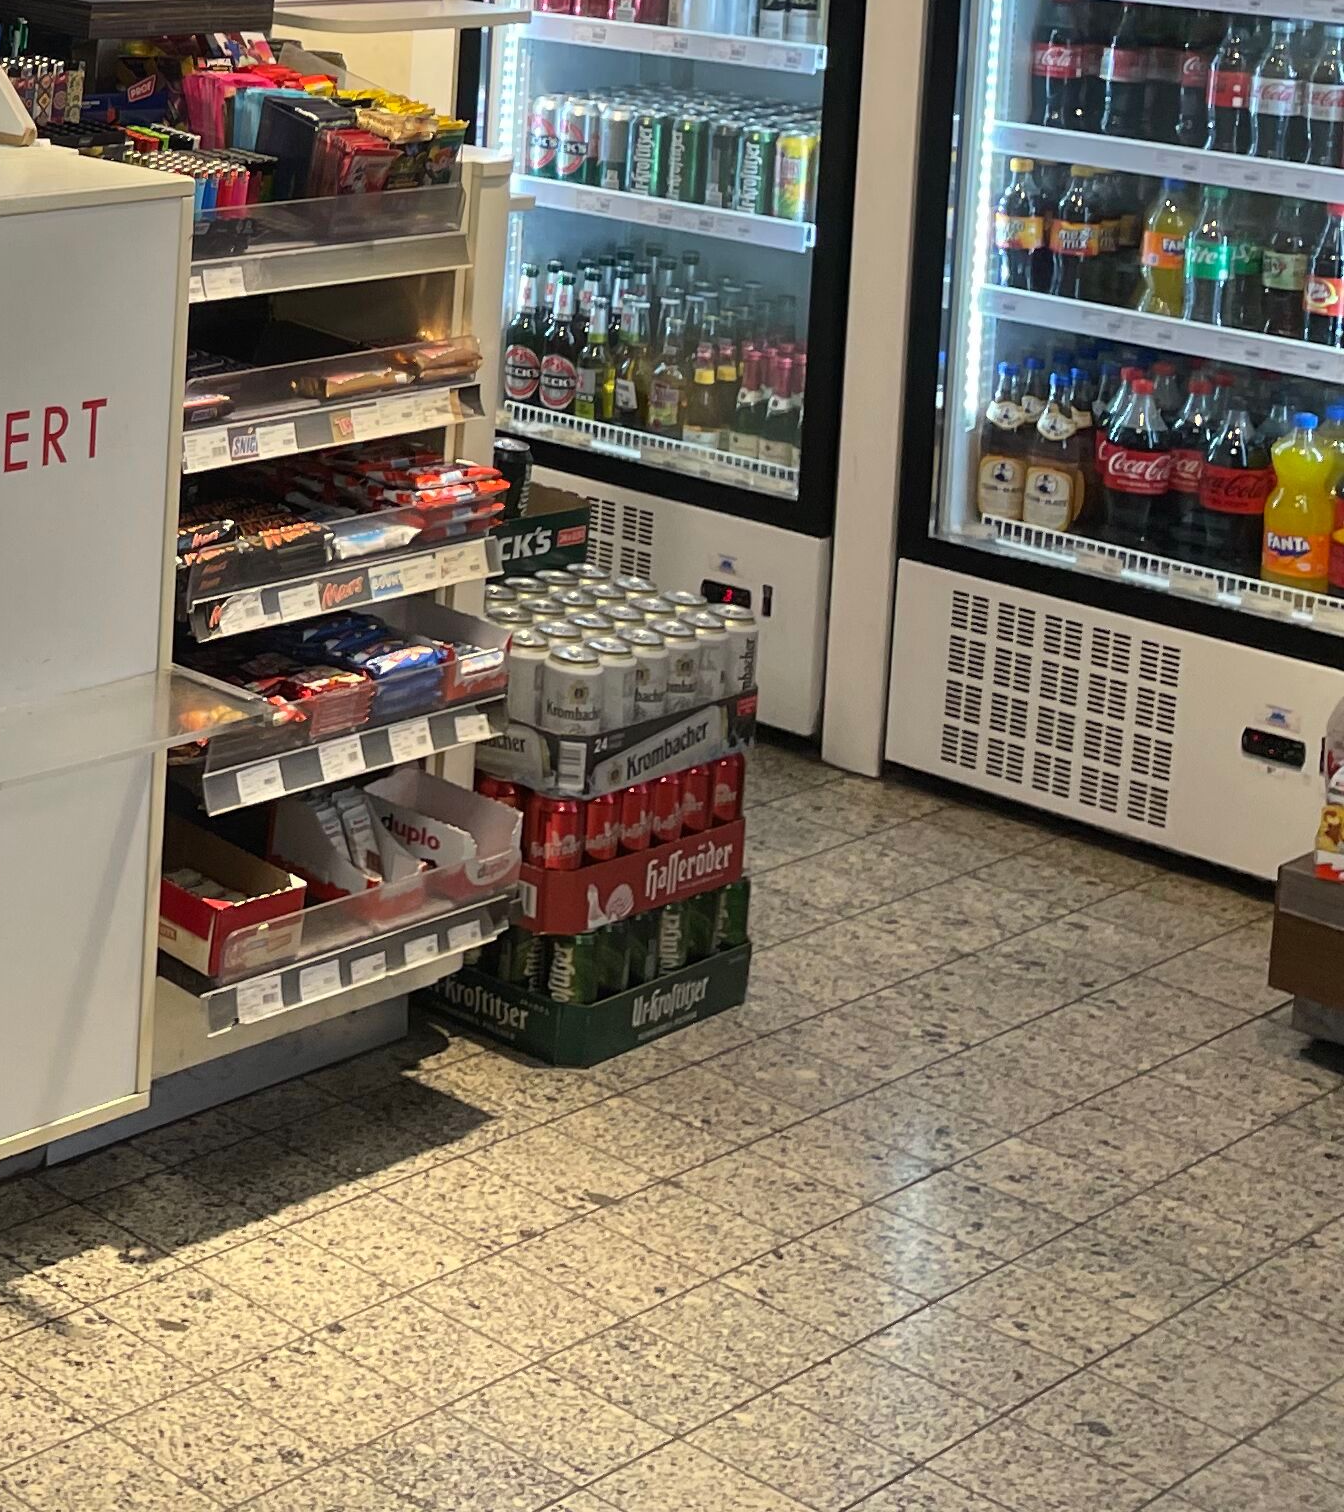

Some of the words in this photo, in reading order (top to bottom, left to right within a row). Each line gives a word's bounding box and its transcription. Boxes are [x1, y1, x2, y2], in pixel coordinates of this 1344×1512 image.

[1162, 238, 1186, 253] FAN
[498, 527, 551, 562] CK'S
[1267, 532, 1310, 554] FANTA
[322, 577, 362, 607] Mars
[594, 739, 608, 753] 24
[627, 720, 708, 781] Krombacher
[381, 813, 440, 850] duplo
